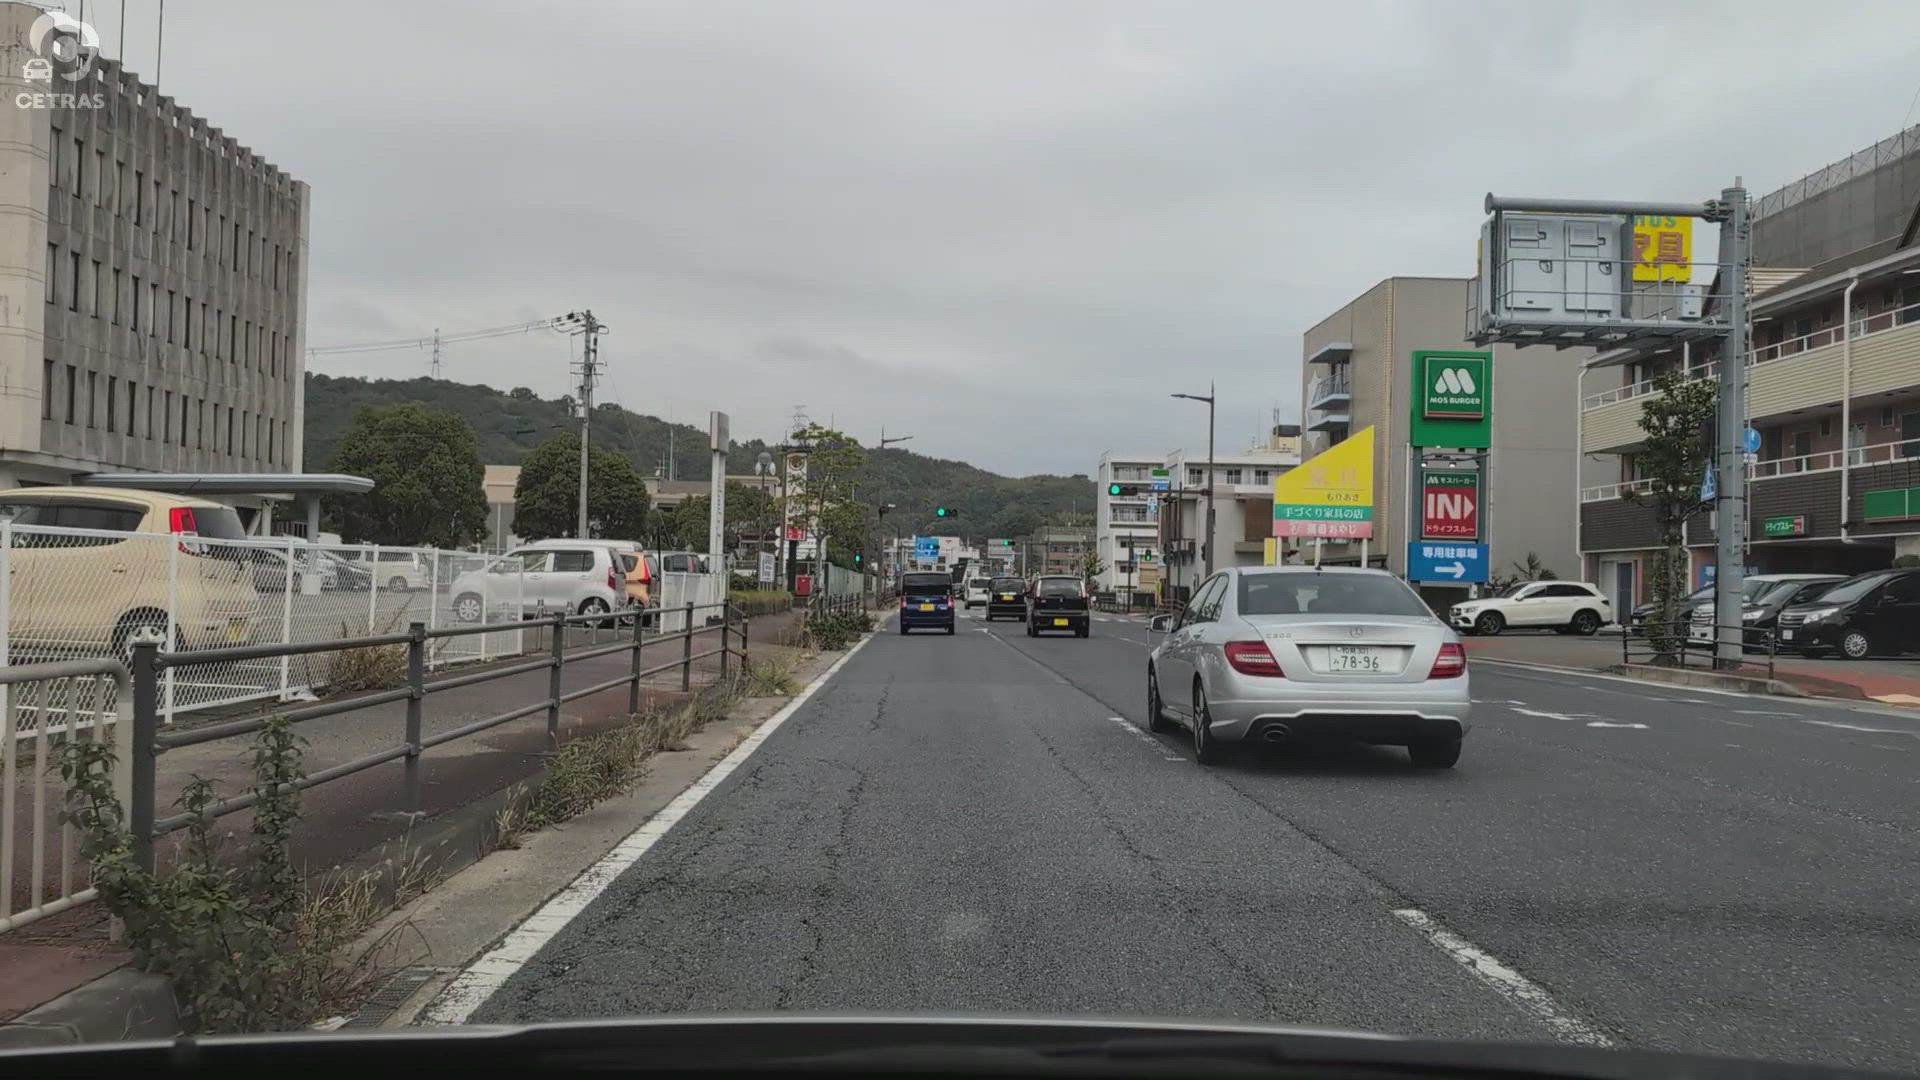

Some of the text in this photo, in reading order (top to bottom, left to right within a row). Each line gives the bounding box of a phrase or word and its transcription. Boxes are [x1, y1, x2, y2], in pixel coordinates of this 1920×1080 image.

[1430, 396, 1481, 405] MOS BURGER
[1440, 476, 1475, 484] モスバーガー
[1427, 493, 1462, 520] IN
[1286, 507, 1364, 519] 手づくり家具の店
[1426, 525, 1475, 533] ドライブスルー
[1423, 547, 1478, 559] 専用駐車場
[1341, 655, 1379, 669] 78-96
